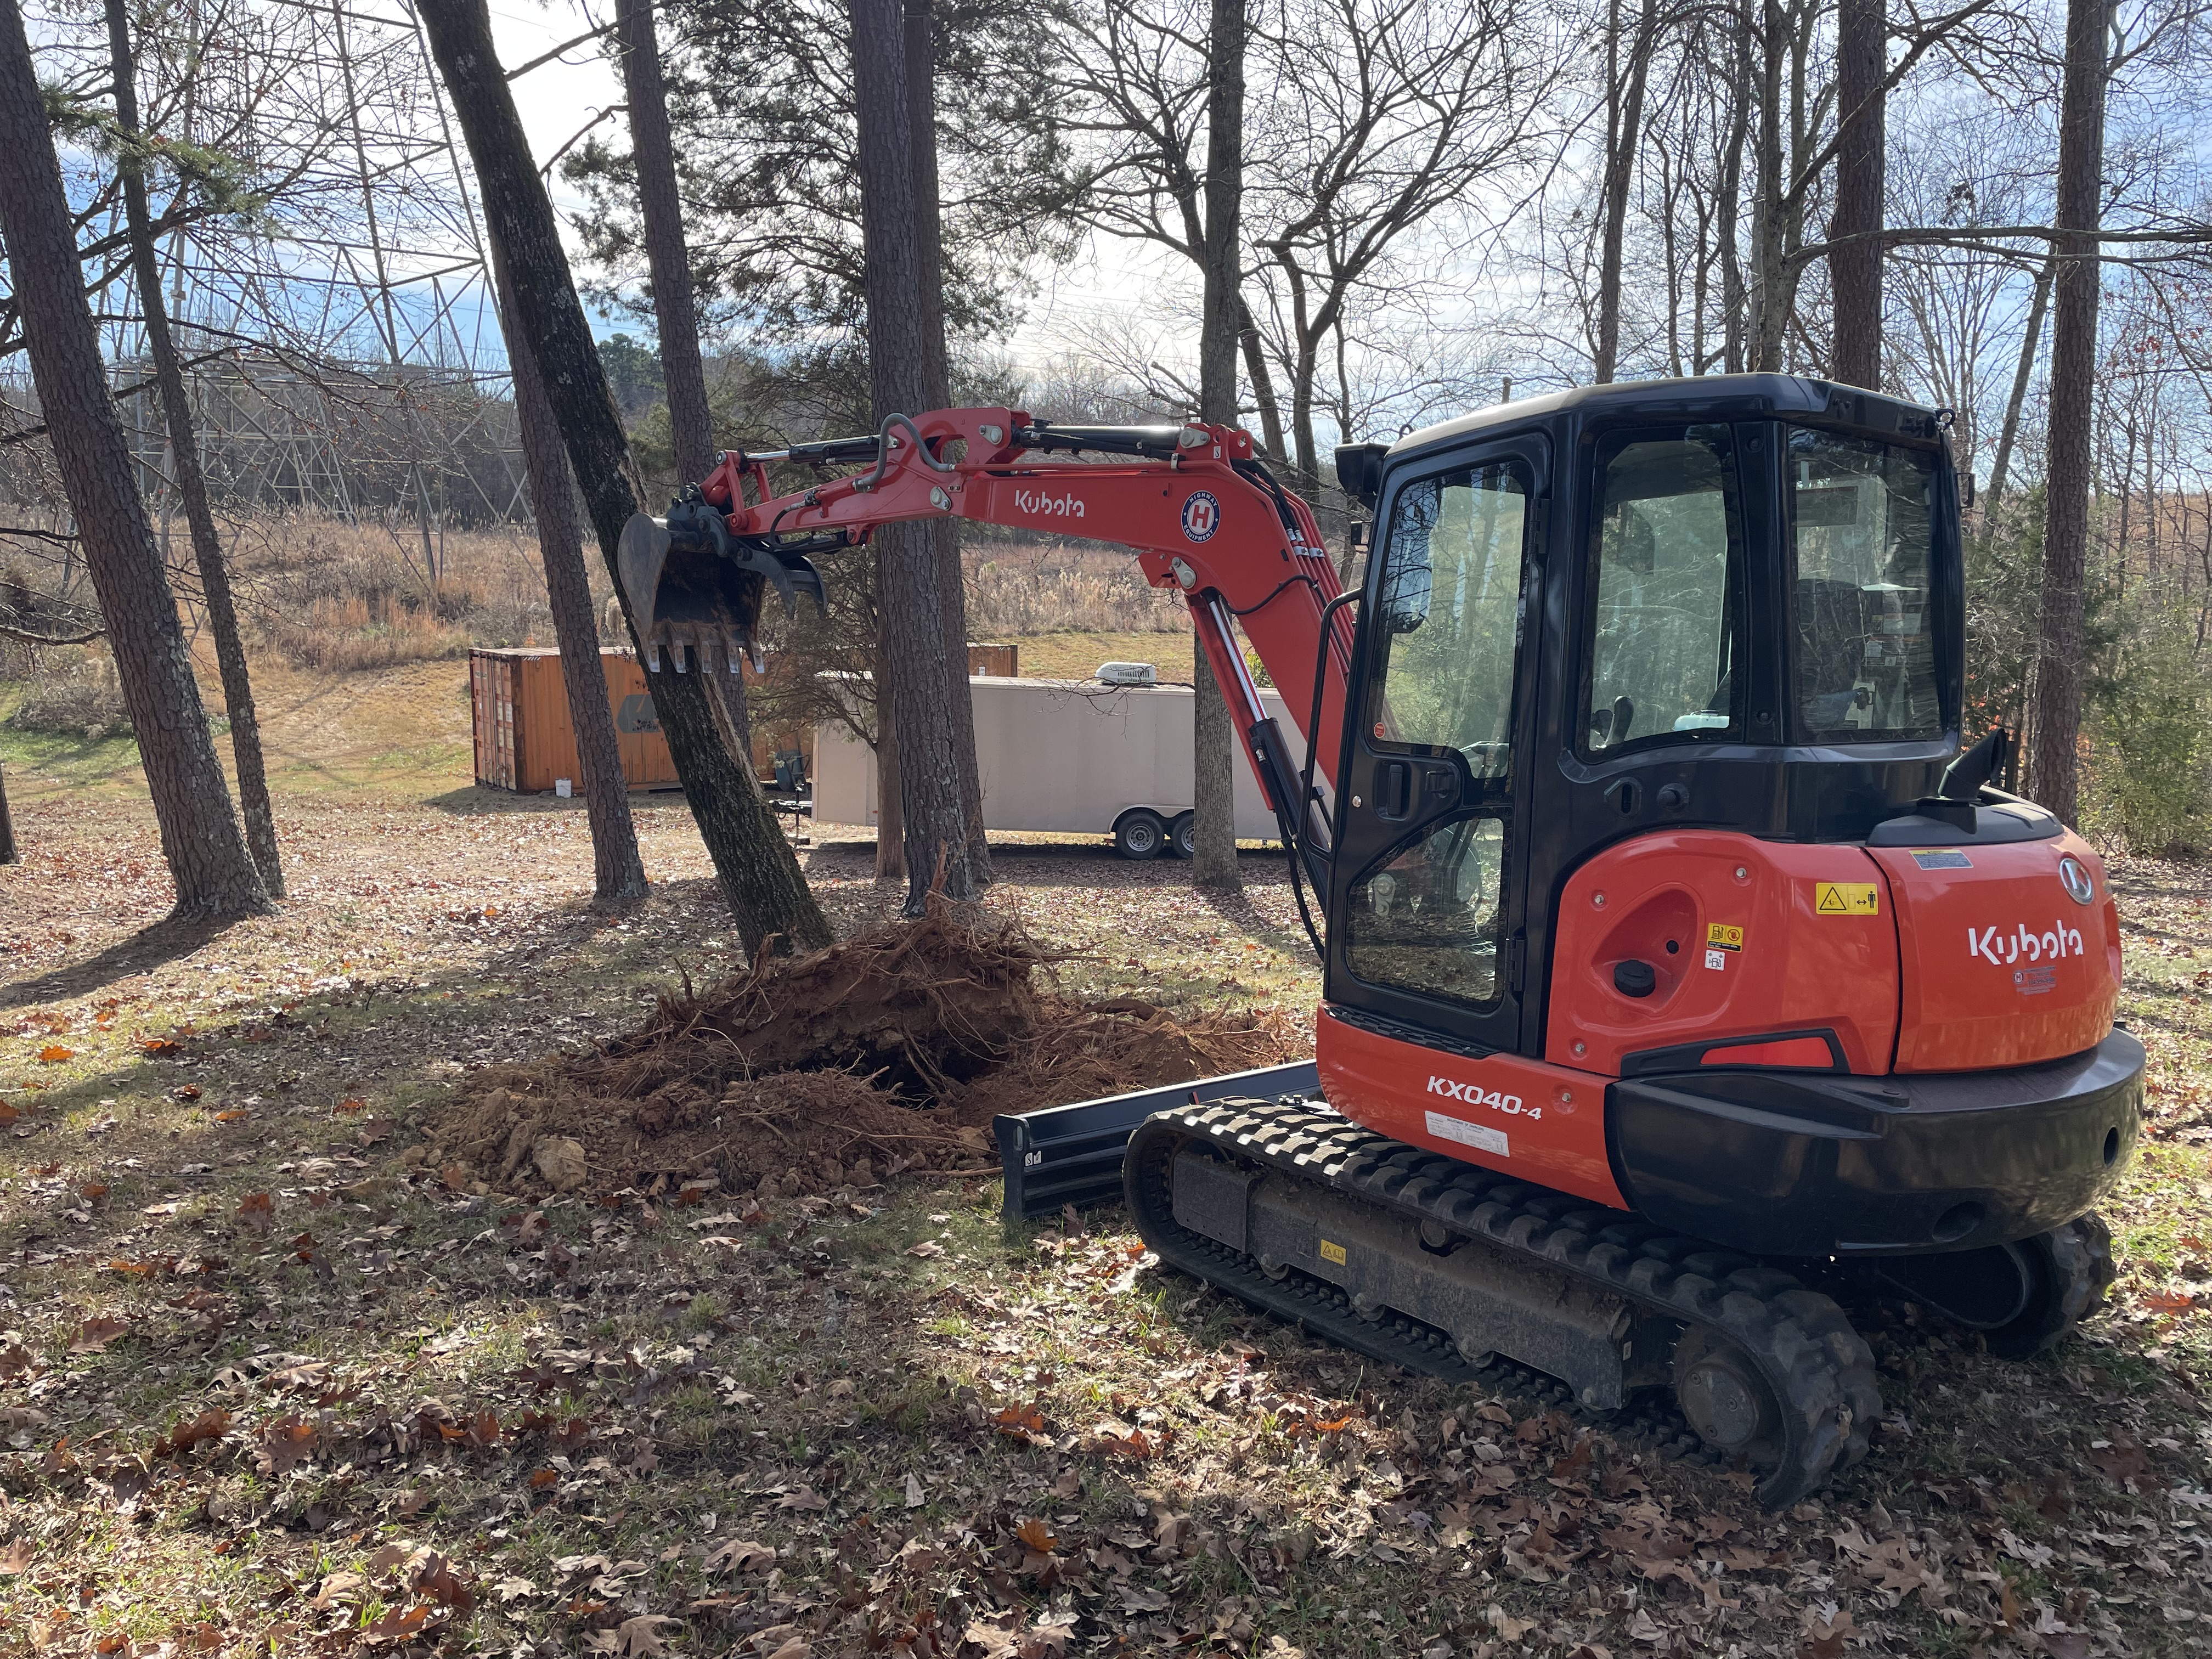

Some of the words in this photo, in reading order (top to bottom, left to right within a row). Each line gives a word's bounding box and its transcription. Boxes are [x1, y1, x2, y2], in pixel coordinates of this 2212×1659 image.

[1015, 490, 1085, 517] Kubota
[1189, 492, 1217, 506] HIGHWAY
[1192, 505, 1210, 529] H
[1183, 524, 1214, 541] EQUIPMENT
[1968, 919, 2084, 965] Kubota
[1427, 1075, 1542, 1120] KX040-4
